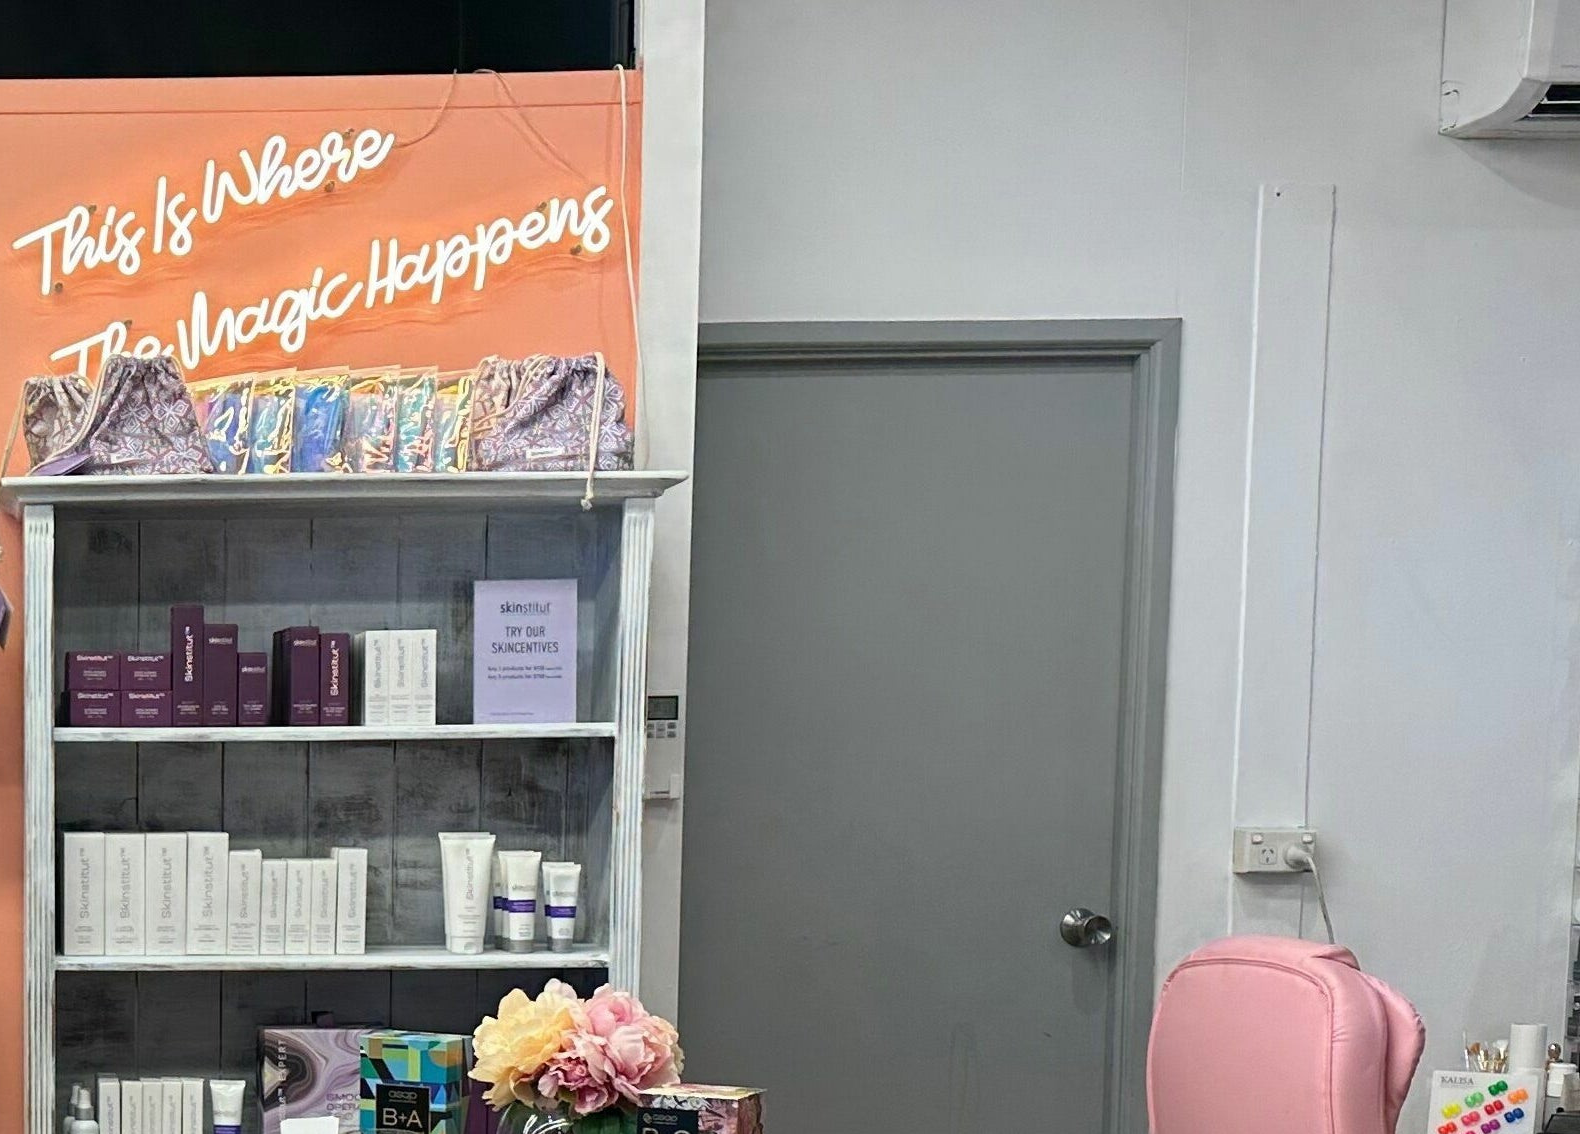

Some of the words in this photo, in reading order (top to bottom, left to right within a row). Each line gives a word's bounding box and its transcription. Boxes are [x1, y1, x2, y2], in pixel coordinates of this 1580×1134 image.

[13, 204, 145, 295] This
[152, 176, 196, 258] Is
[203, 128, 396, 225] Where
[177, 266, 365, 370] Magic
[365, 185, 614, 308] Happens
[500, 600, 551, 614] skinstitut
[505, 626, 523, 637] TRY
[526, 626, 546, 637] OUR
[491, 641, 559, 654] SKINCENTIVES
[388, 1089, 418, 1101] asap
[382, 1107, 423, 1129] B+A
